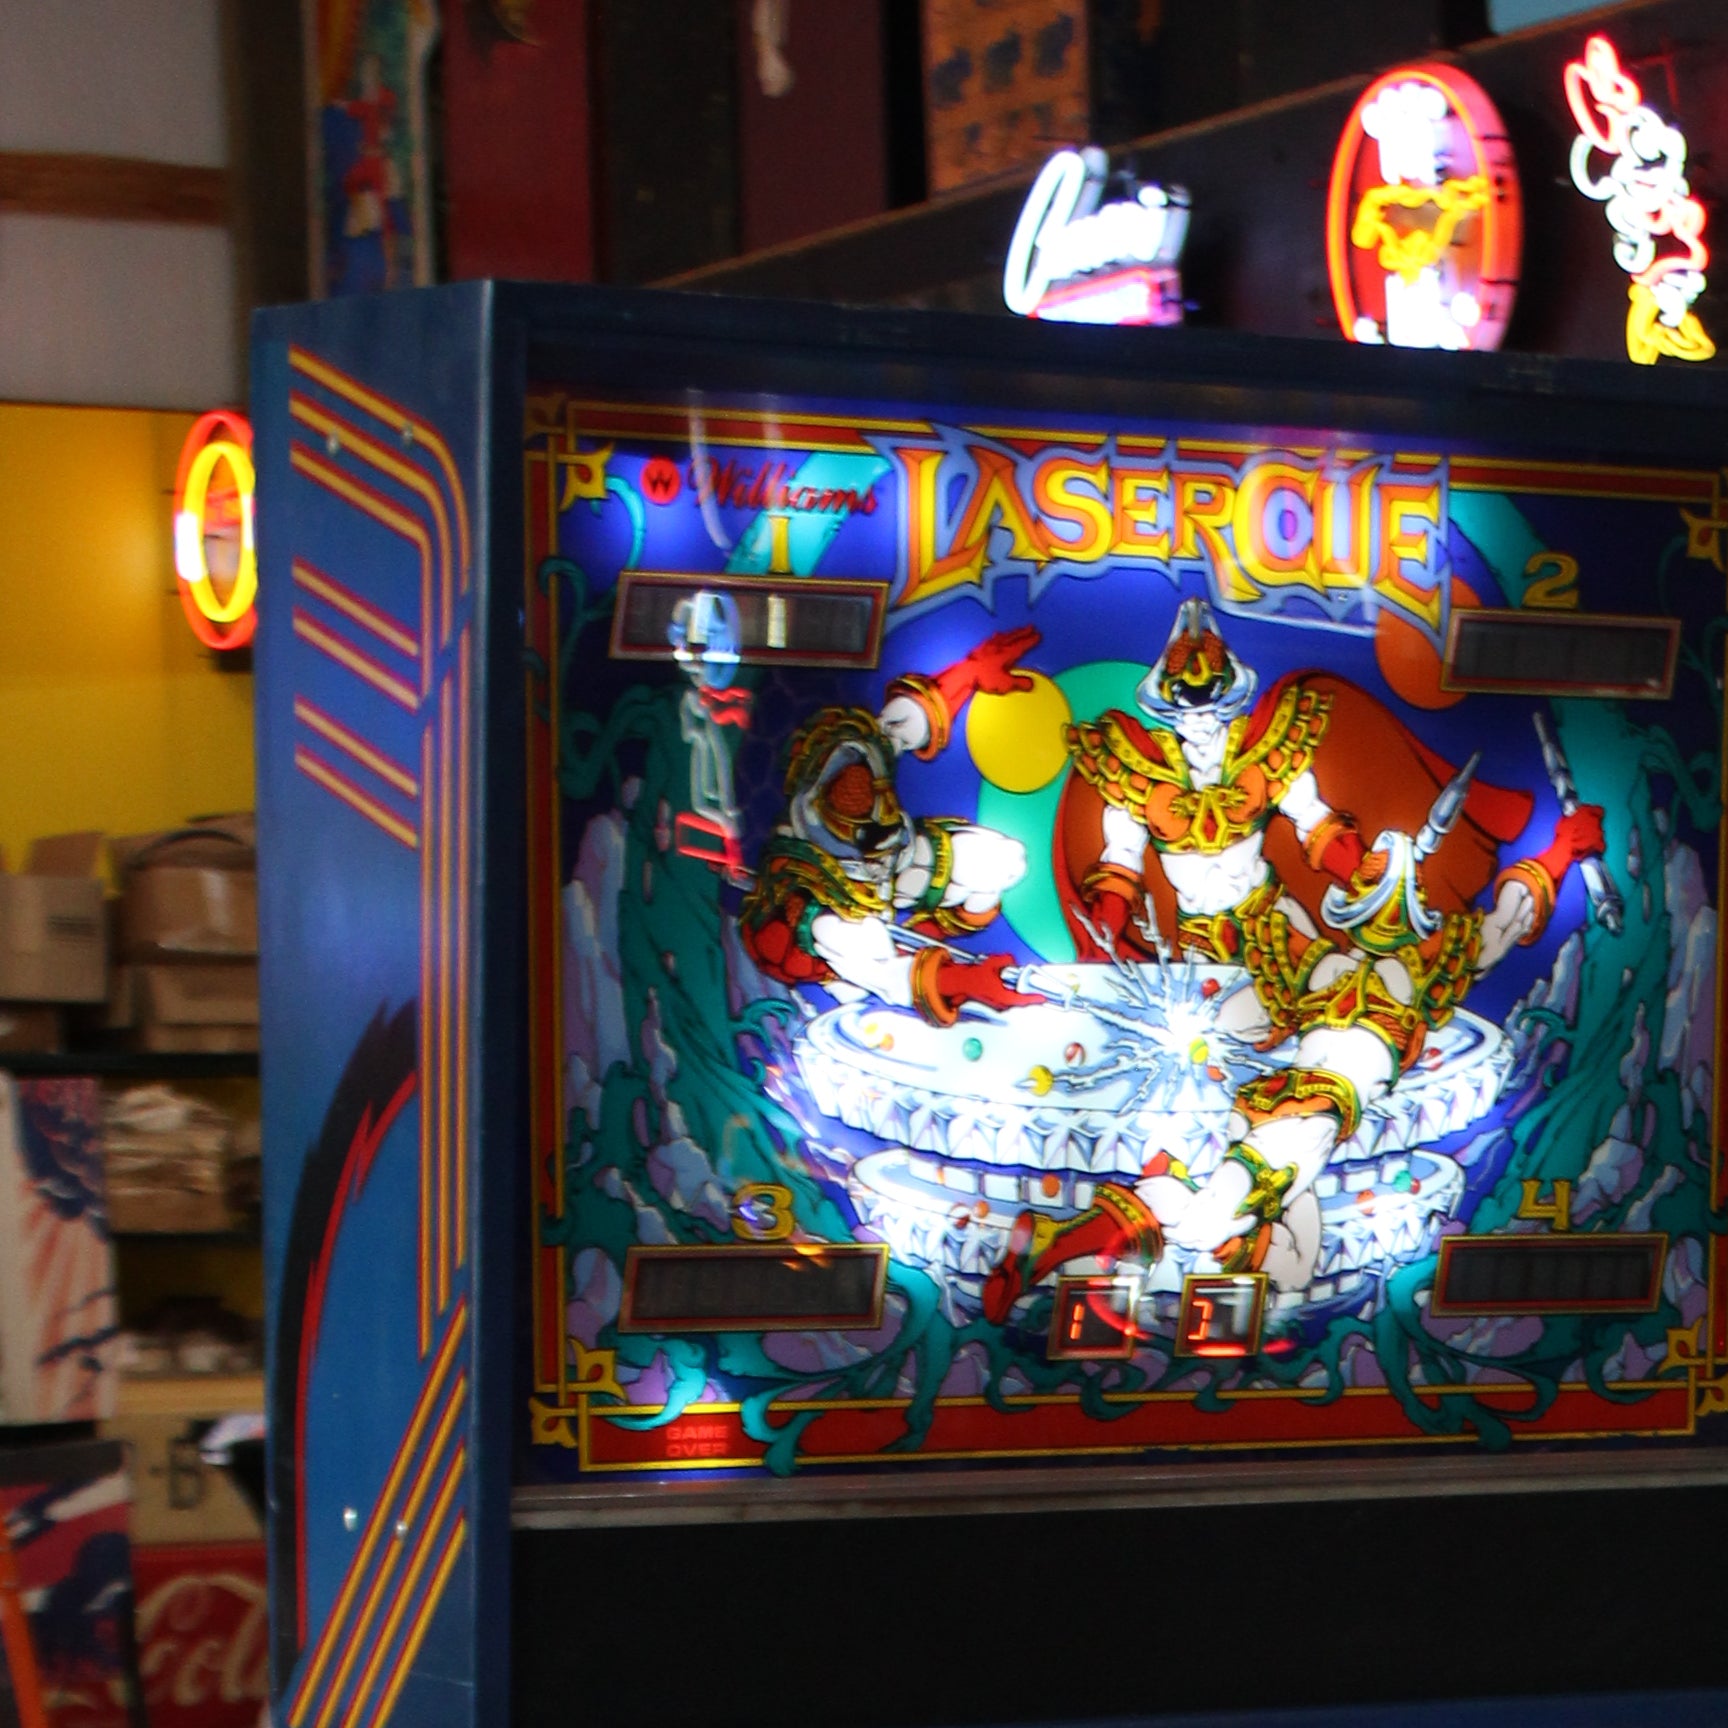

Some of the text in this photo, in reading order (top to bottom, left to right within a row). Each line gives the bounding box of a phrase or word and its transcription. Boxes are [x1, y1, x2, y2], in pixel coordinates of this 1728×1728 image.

[687, 457, 879, 515] Williams
[1523, 552, 1581, 609] 2
[730, 1181, 797, 1242] 3
[1516, 1177, 1572, 1231] 4
[665, 1425, 729, 1440] GAME
[665, 1442, 728, 1457] OVER
